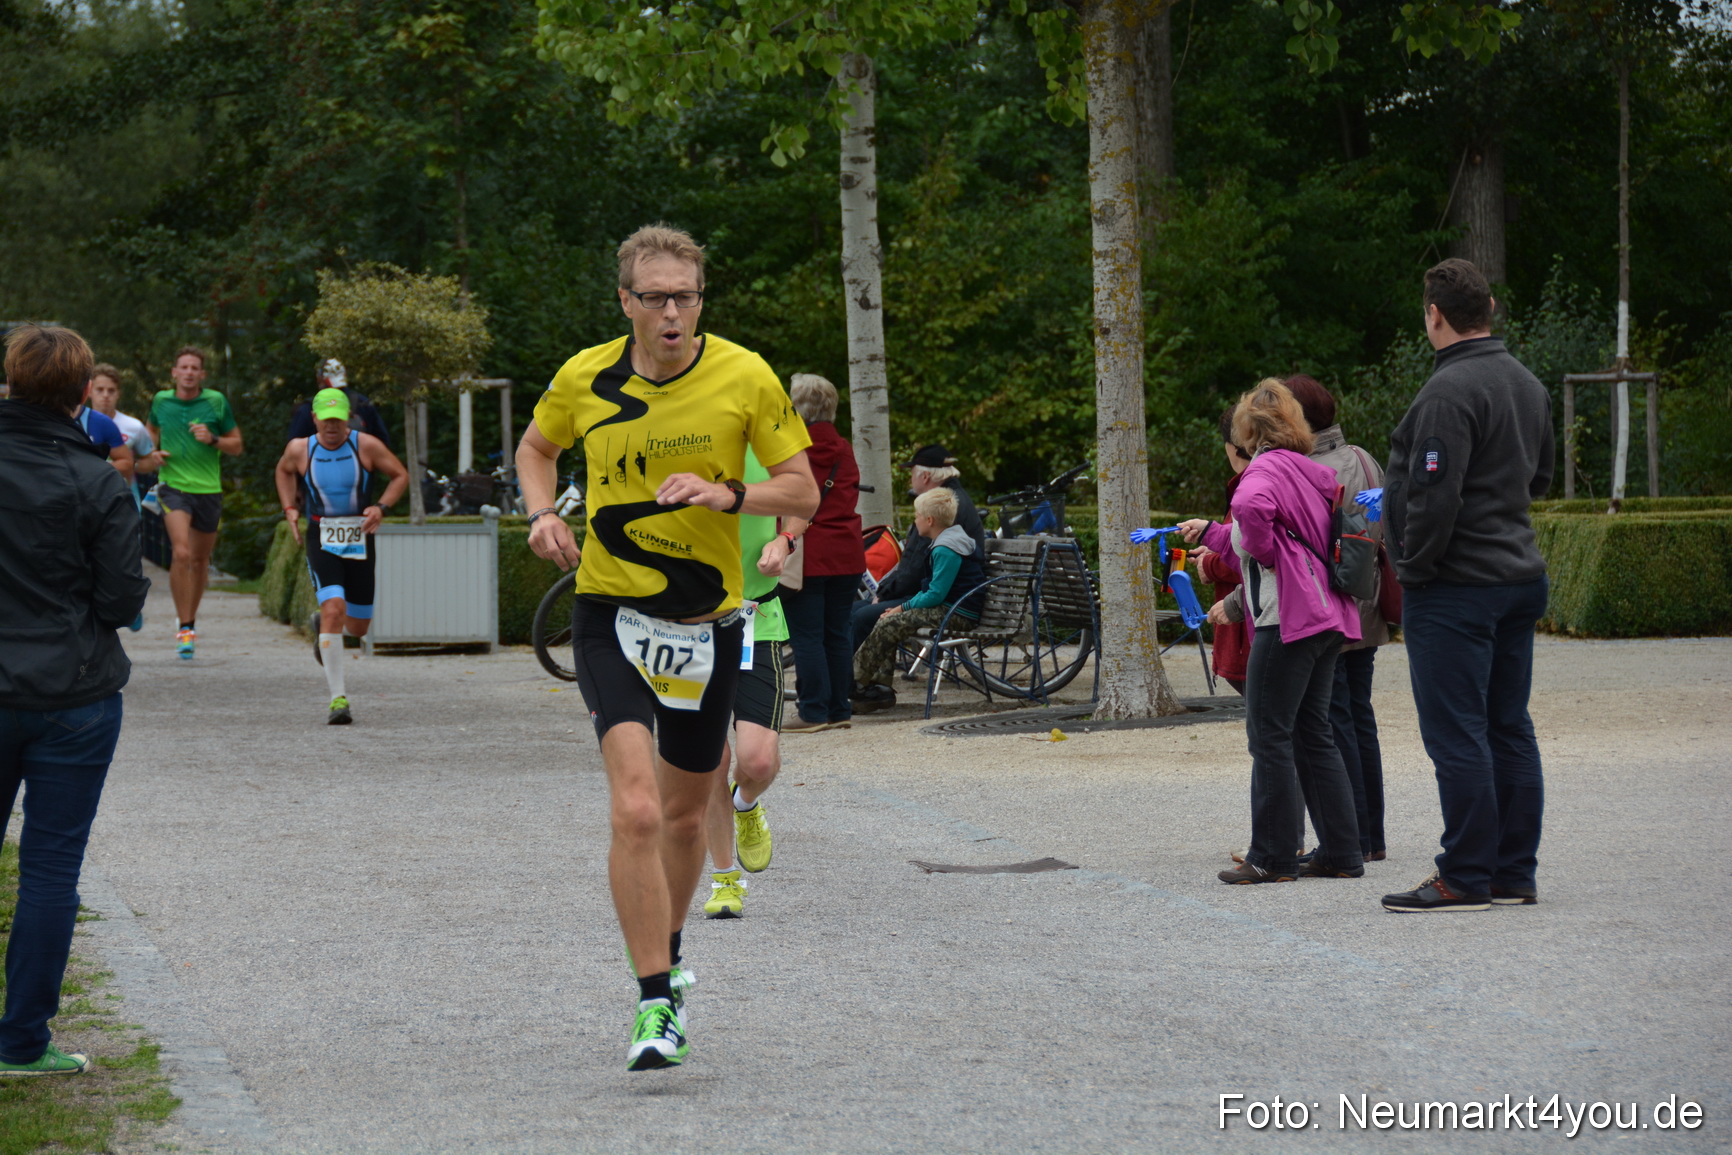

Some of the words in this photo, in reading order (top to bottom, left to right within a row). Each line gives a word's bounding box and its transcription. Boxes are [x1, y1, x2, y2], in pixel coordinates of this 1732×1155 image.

[647, 433, 712, 450] Triathlon
[648, 444, 713, 459] HILPOLTSTEIN
[326, 526, 362, 543] 2029
[629, 528, 693, 552] KLINGELE
[635, 637, 694, 676] 107
